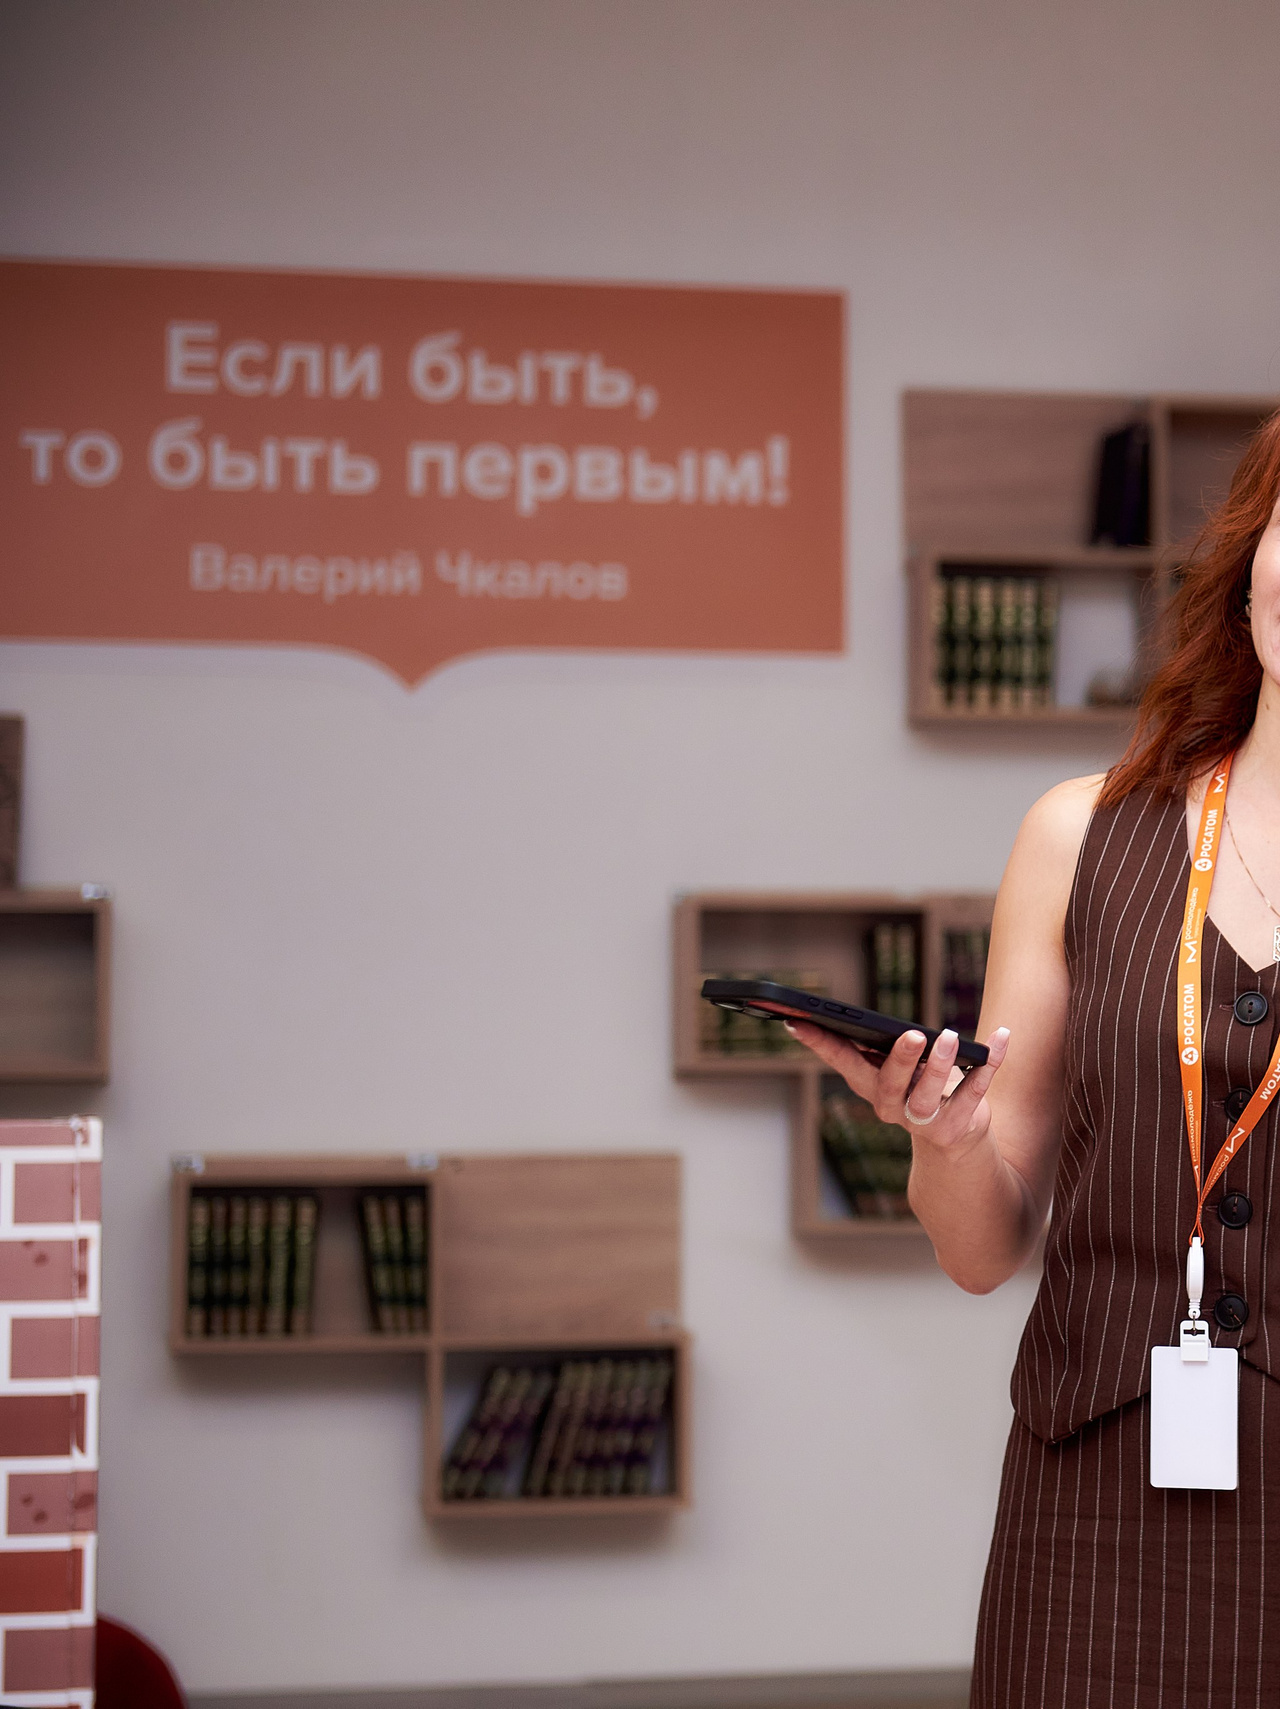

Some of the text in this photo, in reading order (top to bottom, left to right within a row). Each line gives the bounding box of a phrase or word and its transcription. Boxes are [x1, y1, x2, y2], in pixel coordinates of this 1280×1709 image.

[164, 320, 659, 418] Если быть,
[21, 419, 791, 516] то быть первым!
[189, 544, 628, 602] Валерий Чкалов
[1200, 808, 1218, 857] РОСАТОМ
[1183, 983, 1195, 1046] РОСАТОМ
